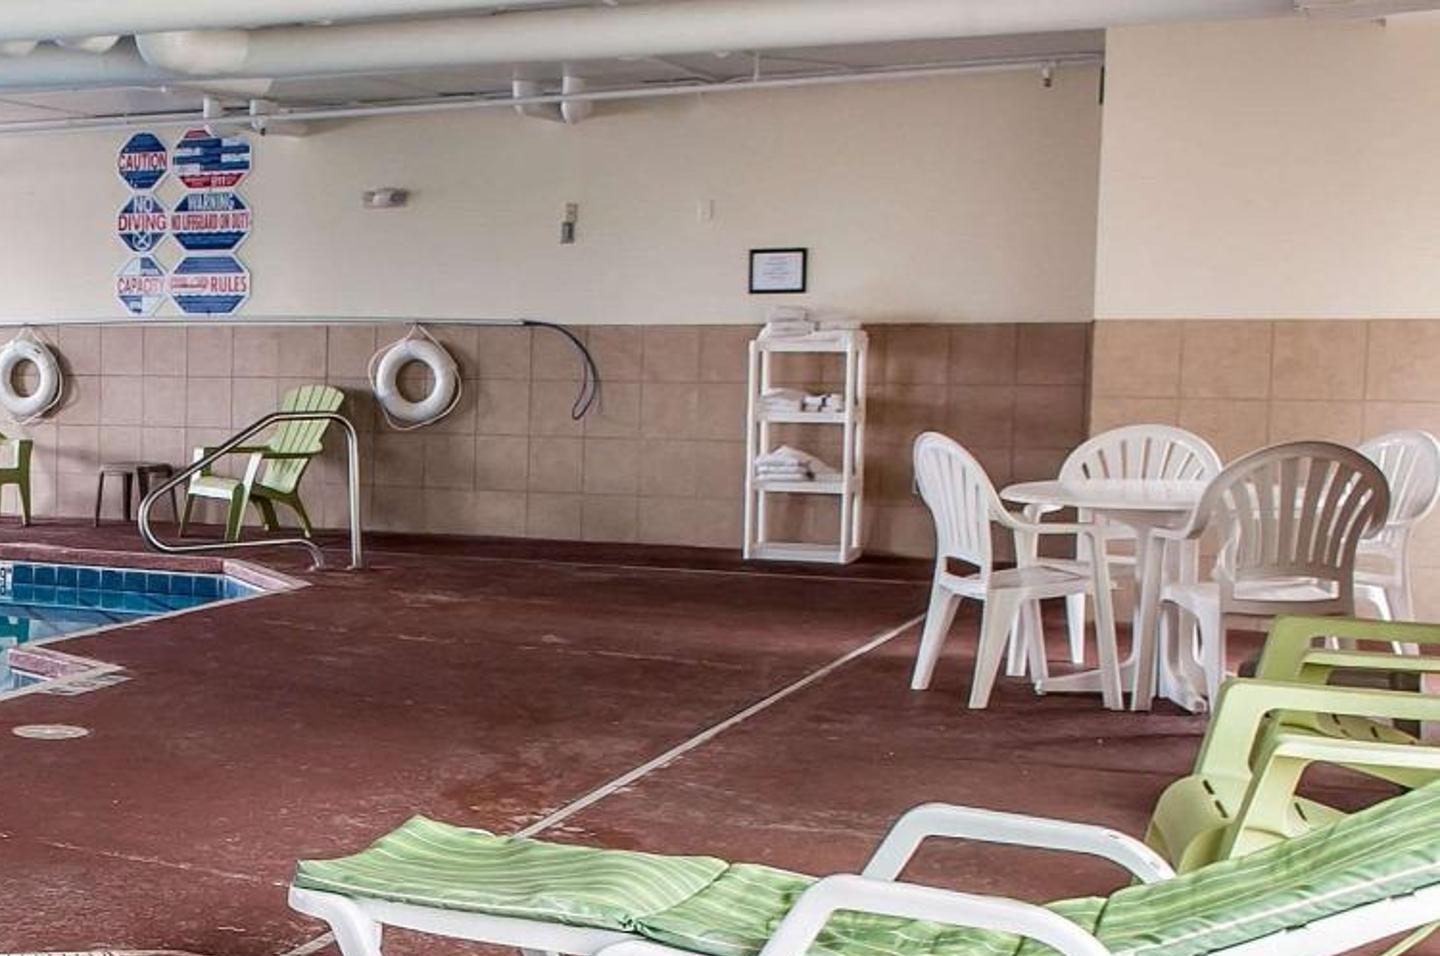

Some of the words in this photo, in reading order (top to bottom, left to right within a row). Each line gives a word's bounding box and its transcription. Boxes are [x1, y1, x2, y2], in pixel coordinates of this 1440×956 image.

[119, 153, 167, 170] CAUTION
[134, 195, 153, 212] NO
[187, 193, 234, 210] WARNING
[118, 215, 166, 231] DIVING
[211, 276, 247, 292] RULES
